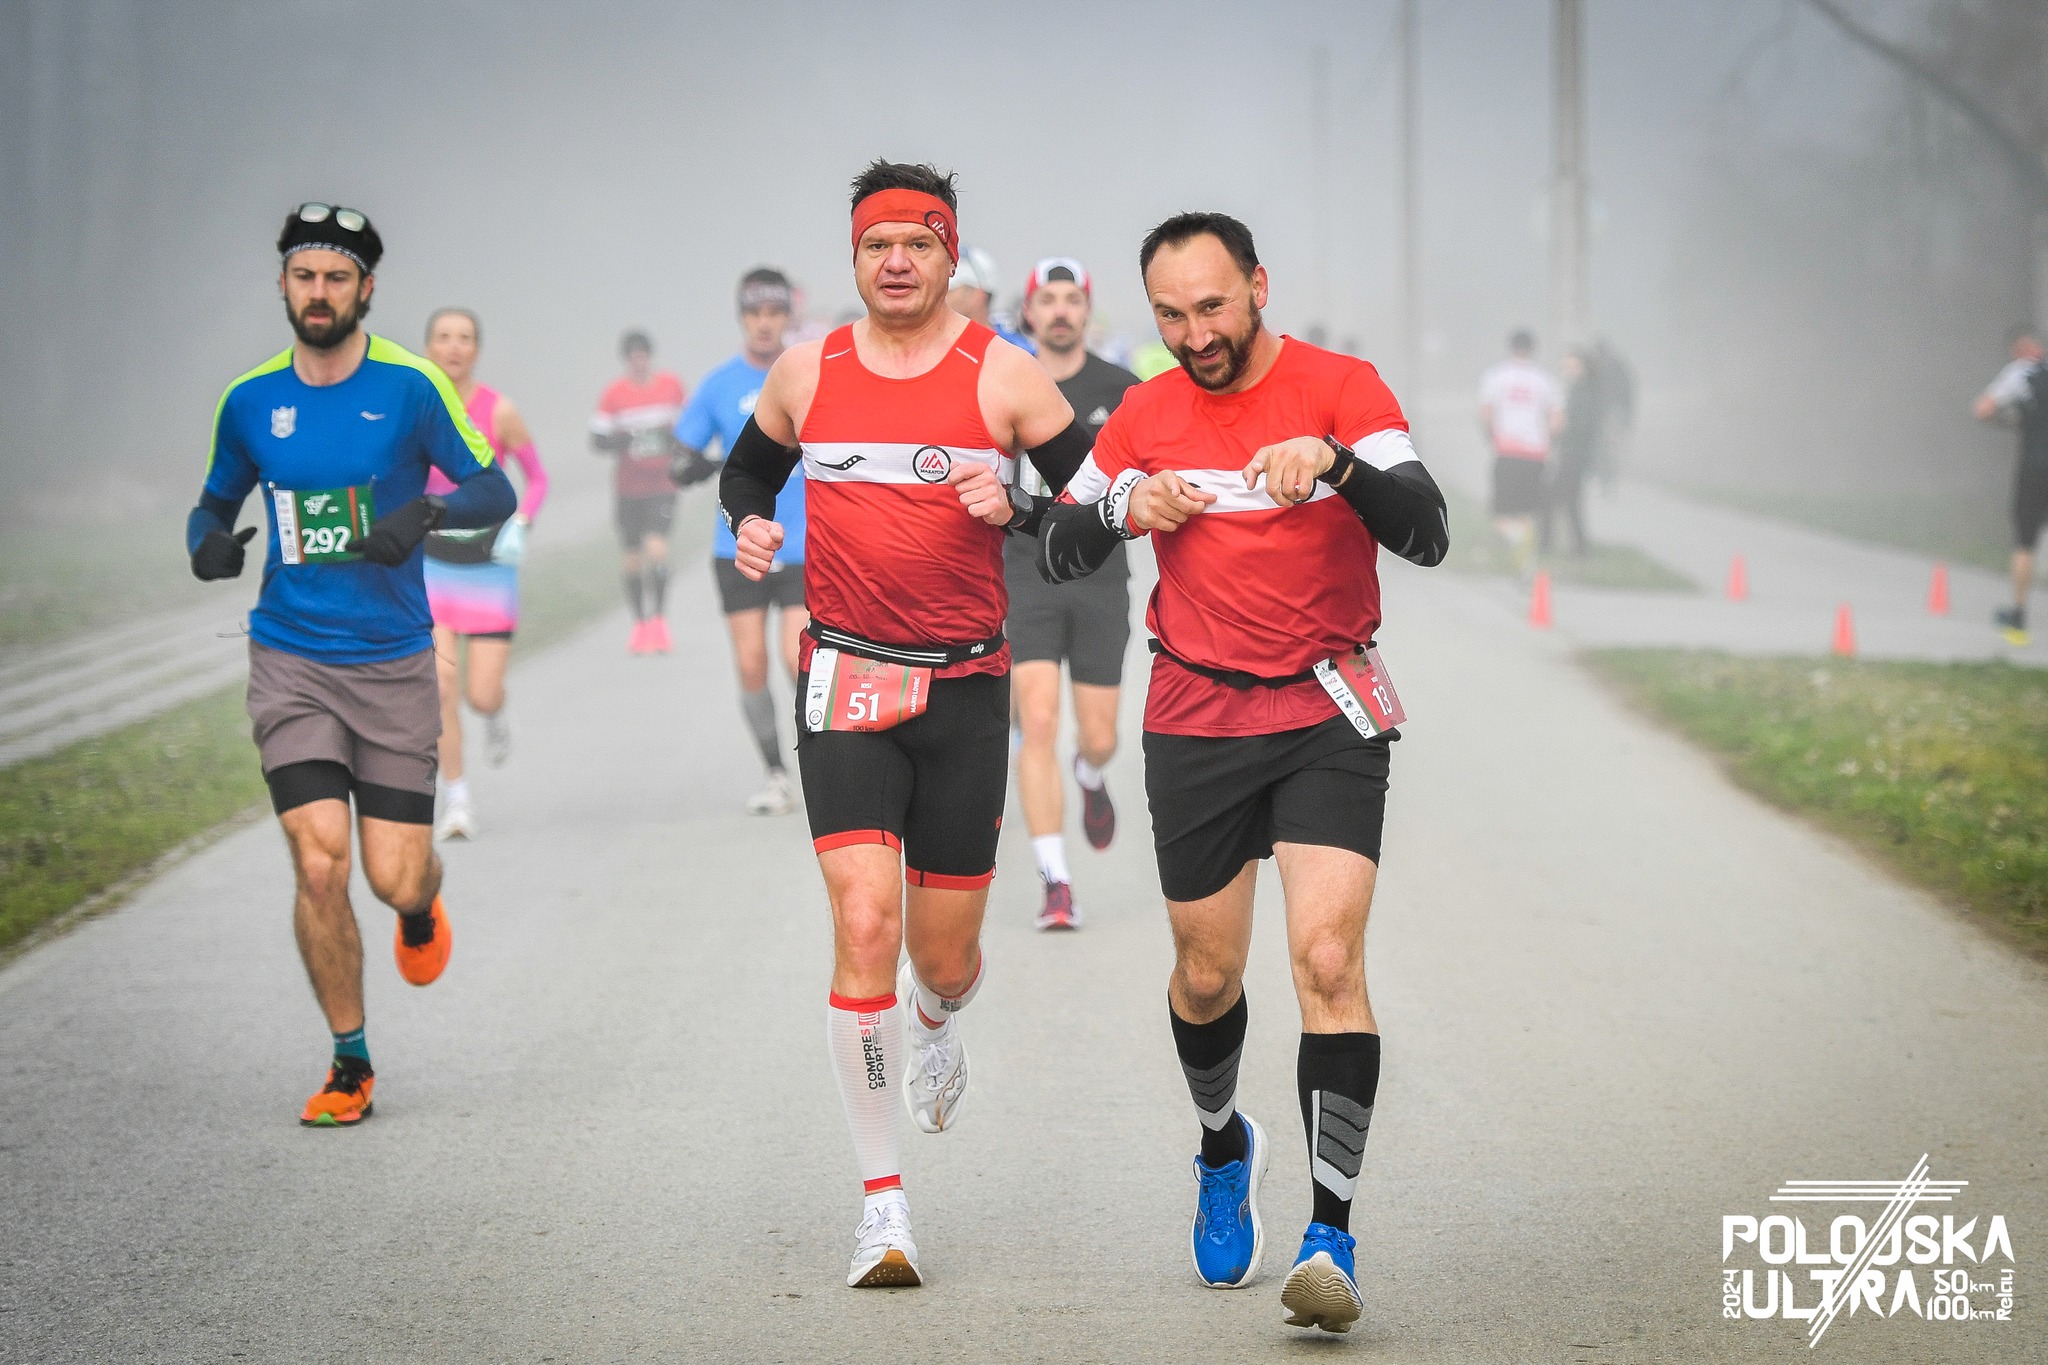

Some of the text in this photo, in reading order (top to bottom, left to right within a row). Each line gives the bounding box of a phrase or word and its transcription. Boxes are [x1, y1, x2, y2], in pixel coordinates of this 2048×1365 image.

[847, 692, 880, 721] 51
[861, 1028, 878, 1090] COMPRES
[874, 1046, 886, 1088] SPORT
